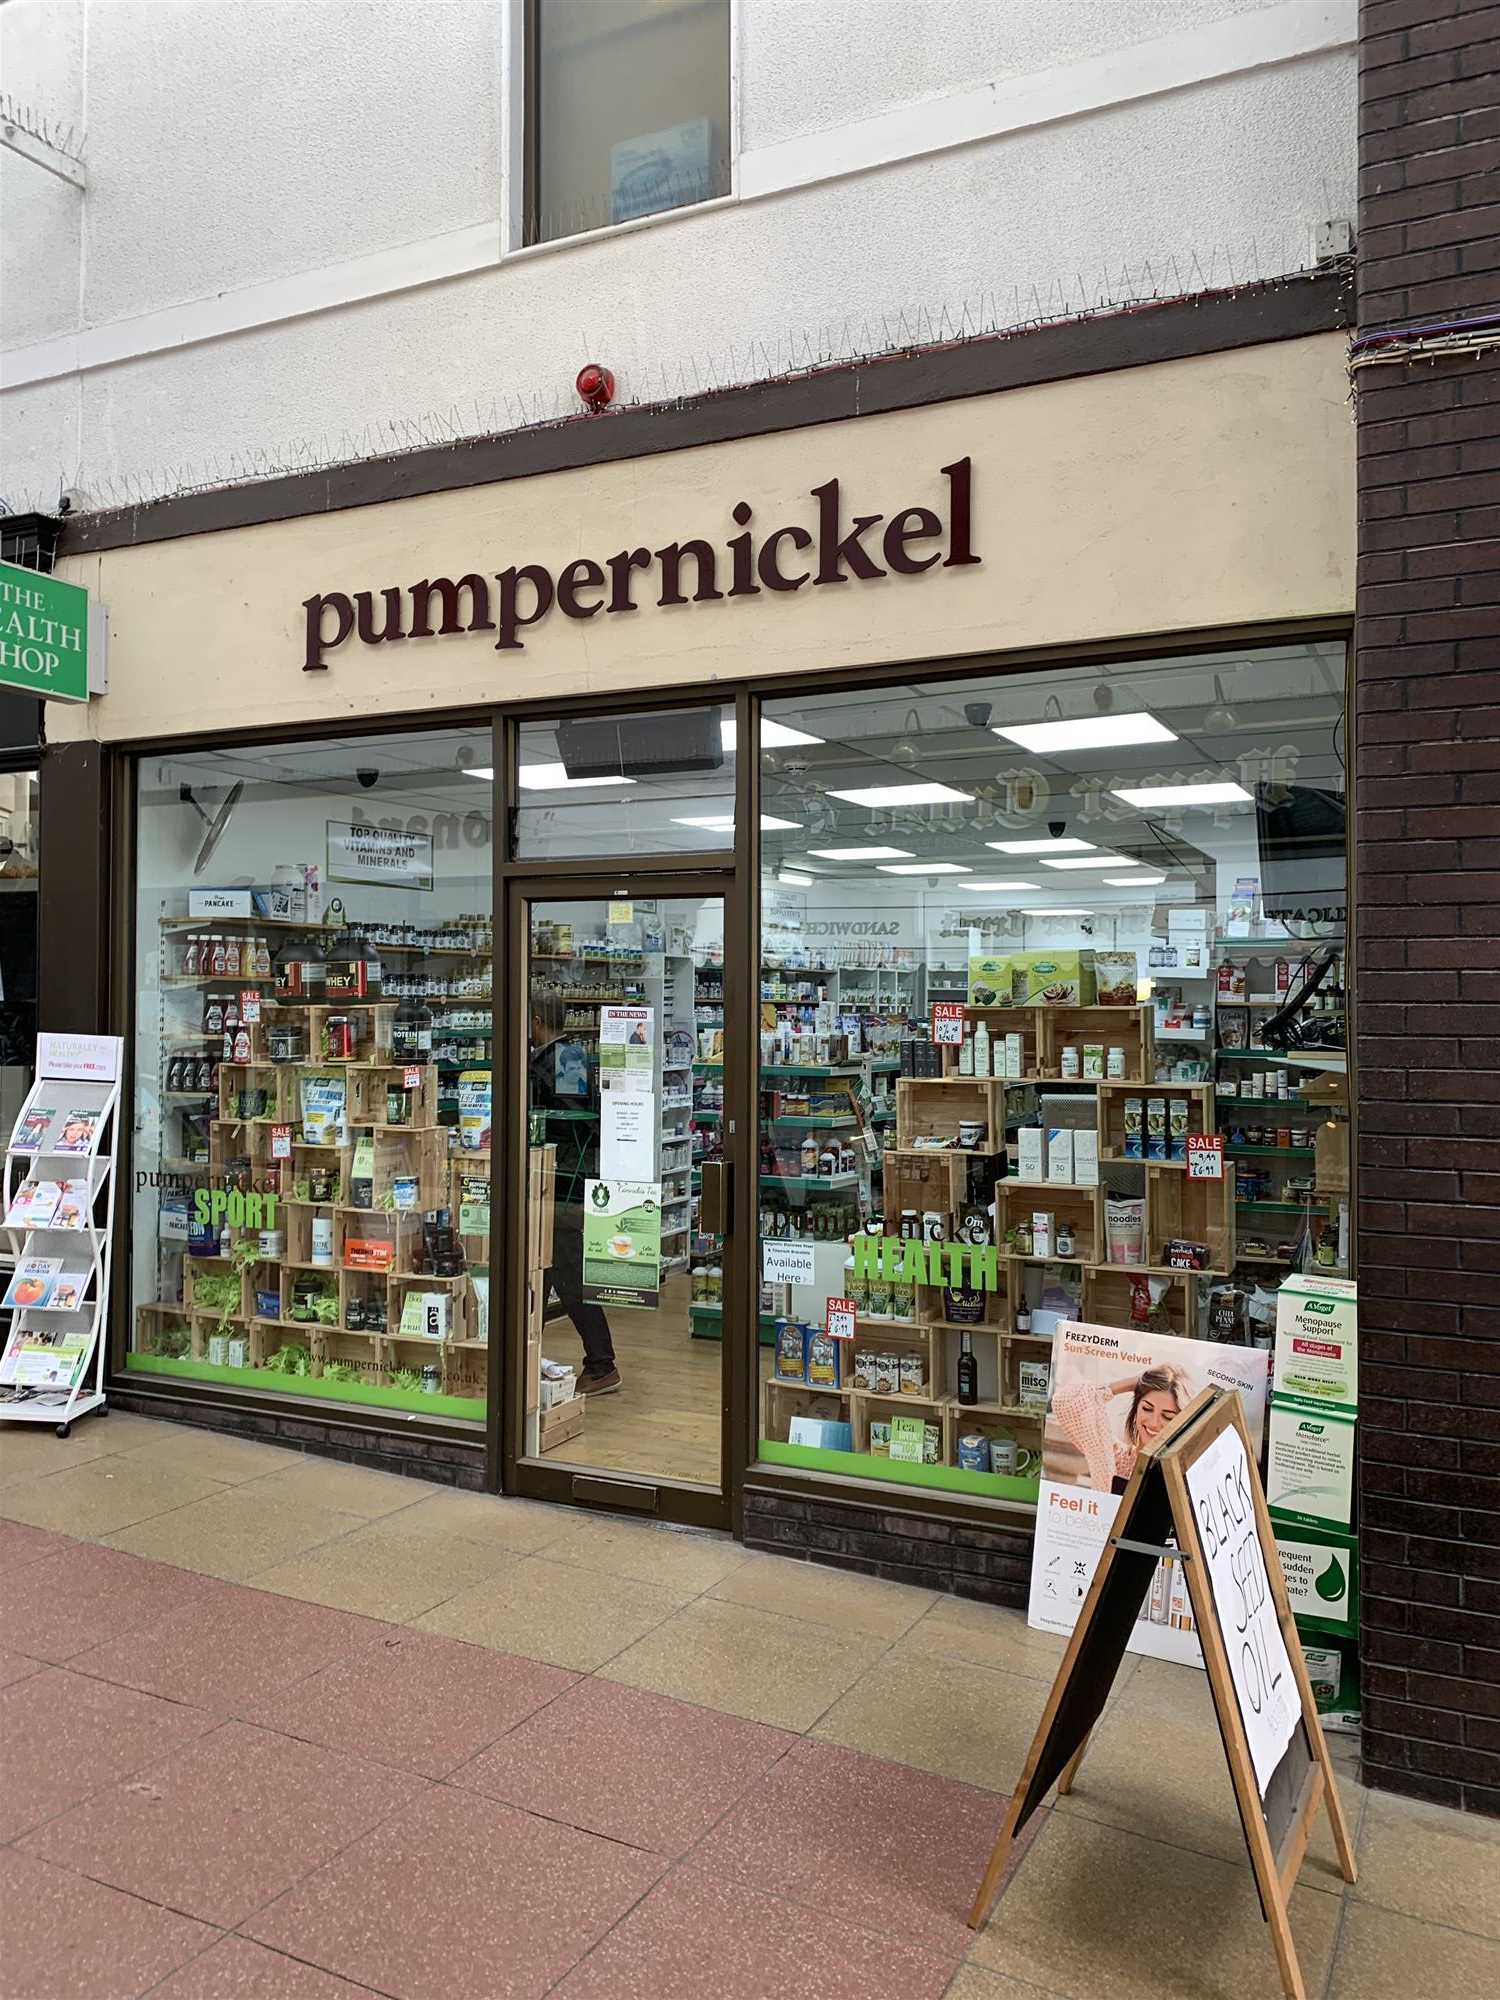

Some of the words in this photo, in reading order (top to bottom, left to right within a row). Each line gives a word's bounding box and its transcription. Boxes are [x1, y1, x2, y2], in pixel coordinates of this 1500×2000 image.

[303, 457, 982, 671] pumpernickel
[0, 583, 45, 611] THE
[0, 608, 82, 652] ALTH
[350, 826, 370, 839] TOP
[373, 830, 415, 844] QUALITY
[344, 839, 392, 856] VITAMINS
[395, 848, 415, 858] AND
[357, 854, 408, 870] MINERALS
[204, 900, 234, 908] PANCAKE
[242, 992, 260, 1001] SALE
[935, 1006, 963, 1018] SALE
[404, 1067, 419, 1075] SALE
[272, 1127, 290, 1136] SALE
[1189, 1137, 1221, 1149] SALE
[194, 1188, 279, 1230] SPORT
[964, 1215, 984, 1228] Om
[1108, 1215, 1141, 1223] noodles
[766, 1257, 812, 1269] Available
[854, 1235, 998, 1292] HEALTH
[1171, 1258, 1191, 1269] CAKE
[777, 1272, 801, 1283] Here
[829, 1300, 856, 1313] SALE
[1295, 1315, 1342, 1330] Menopause
[1302, 1324, 1334, 1336] Support
[1066, 1330, 1119, 1348] FREZYDERM
[1064, 1343, 1083, 1354] Sun
[1084, 1344, 1118, 1360] Screen
[1120, 1351, 1153, 1365] Velvet
[1207, 1368, 1236, 1386] SECOND
[1237, 1379, 1253, 1391] SKIN
[894, 1419, 915, 1433] Tea
[1050, 1492, 1082, 1513] Feel
[1088, 1500, 1099, 1516] it
[1200, 1454, 1253, 1560] BLACK
[1278, 1549, 1311, 1564] requent
[1282, 1562, 1314, 1576] sudden
[1230, 1530, 1265, 1633] SEED
[1300, 1576, 1308, 1585] to
[1242, 1618, 1282, 1715] OIL
